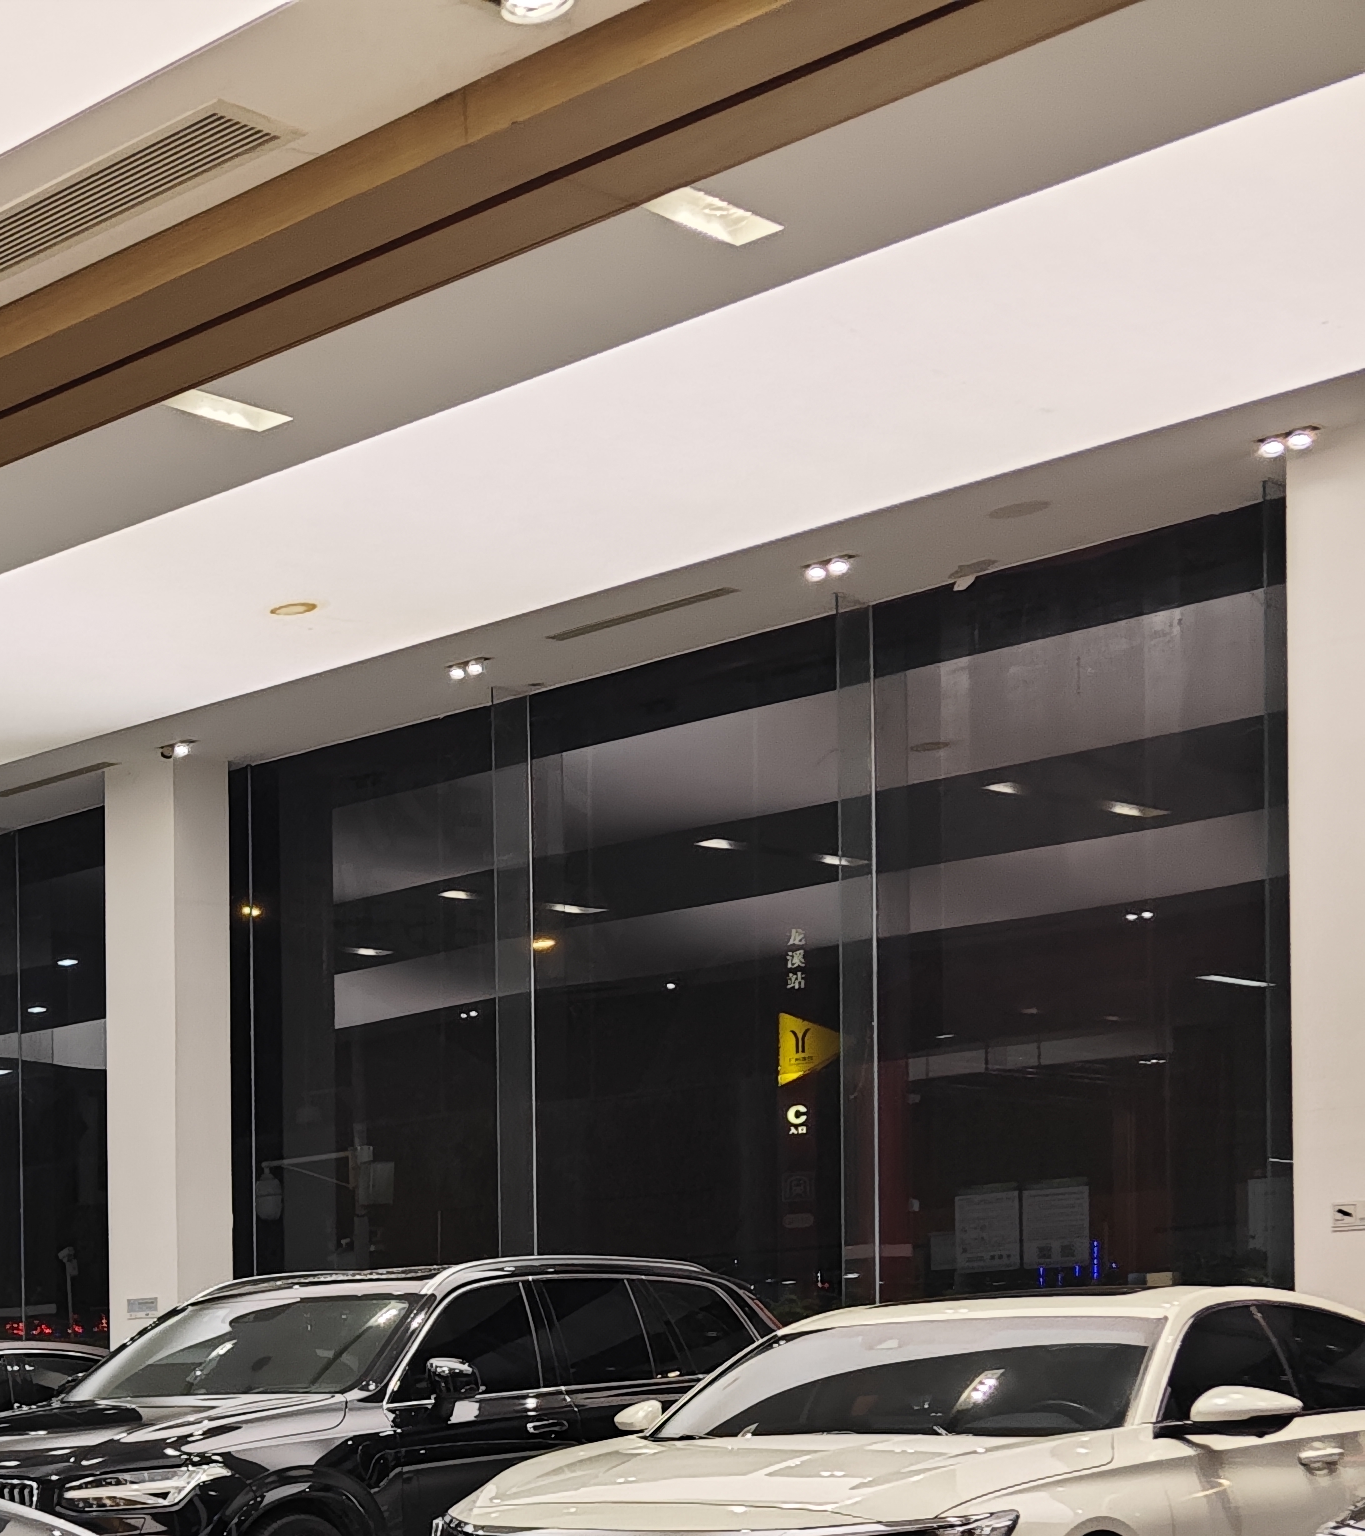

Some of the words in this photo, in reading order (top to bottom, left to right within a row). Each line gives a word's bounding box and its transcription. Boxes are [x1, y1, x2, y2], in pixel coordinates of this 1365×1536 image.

[786, 928, 806, 989] 龙溪站
[787, 1104, 808, 1125] C
